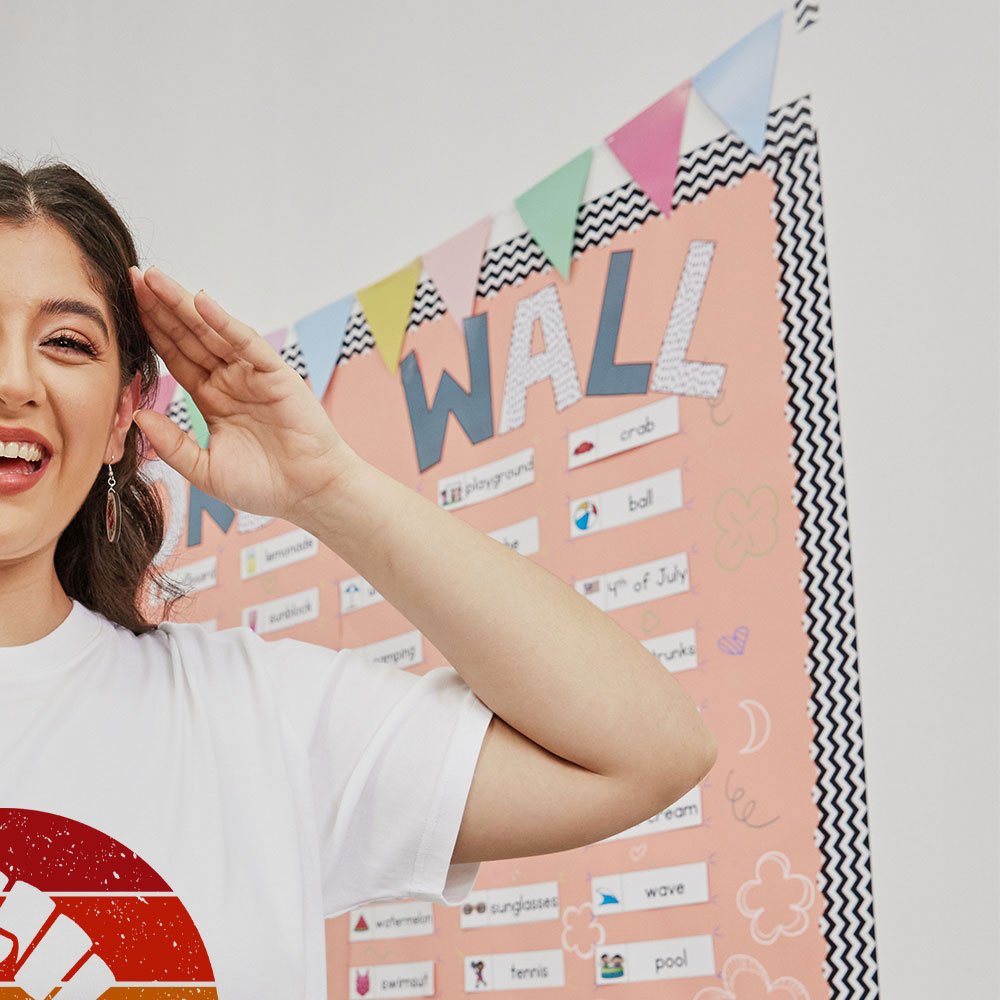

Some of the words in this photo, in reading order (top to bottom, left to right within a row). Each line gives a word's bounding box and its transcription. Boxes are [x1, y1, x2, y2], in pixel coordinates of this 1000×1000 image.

[400, 240, 728, 473] WALL
[621, 415, 655, 441] crab
[464, 453, 534, 497] playground
[628, 488, 655, 512] ball
[266, 537, 314, 563] lemonade
[633, 571, 649, 594] of
[655, 563, 689, 588] July
[644, 881, 685, 899] wave
[490, 894, 559, 918] sunglasses
[375, 912, 433, 929] watermelon
[510, 966, 549, 980] tennis
[655, 947, 689, 975] pool
